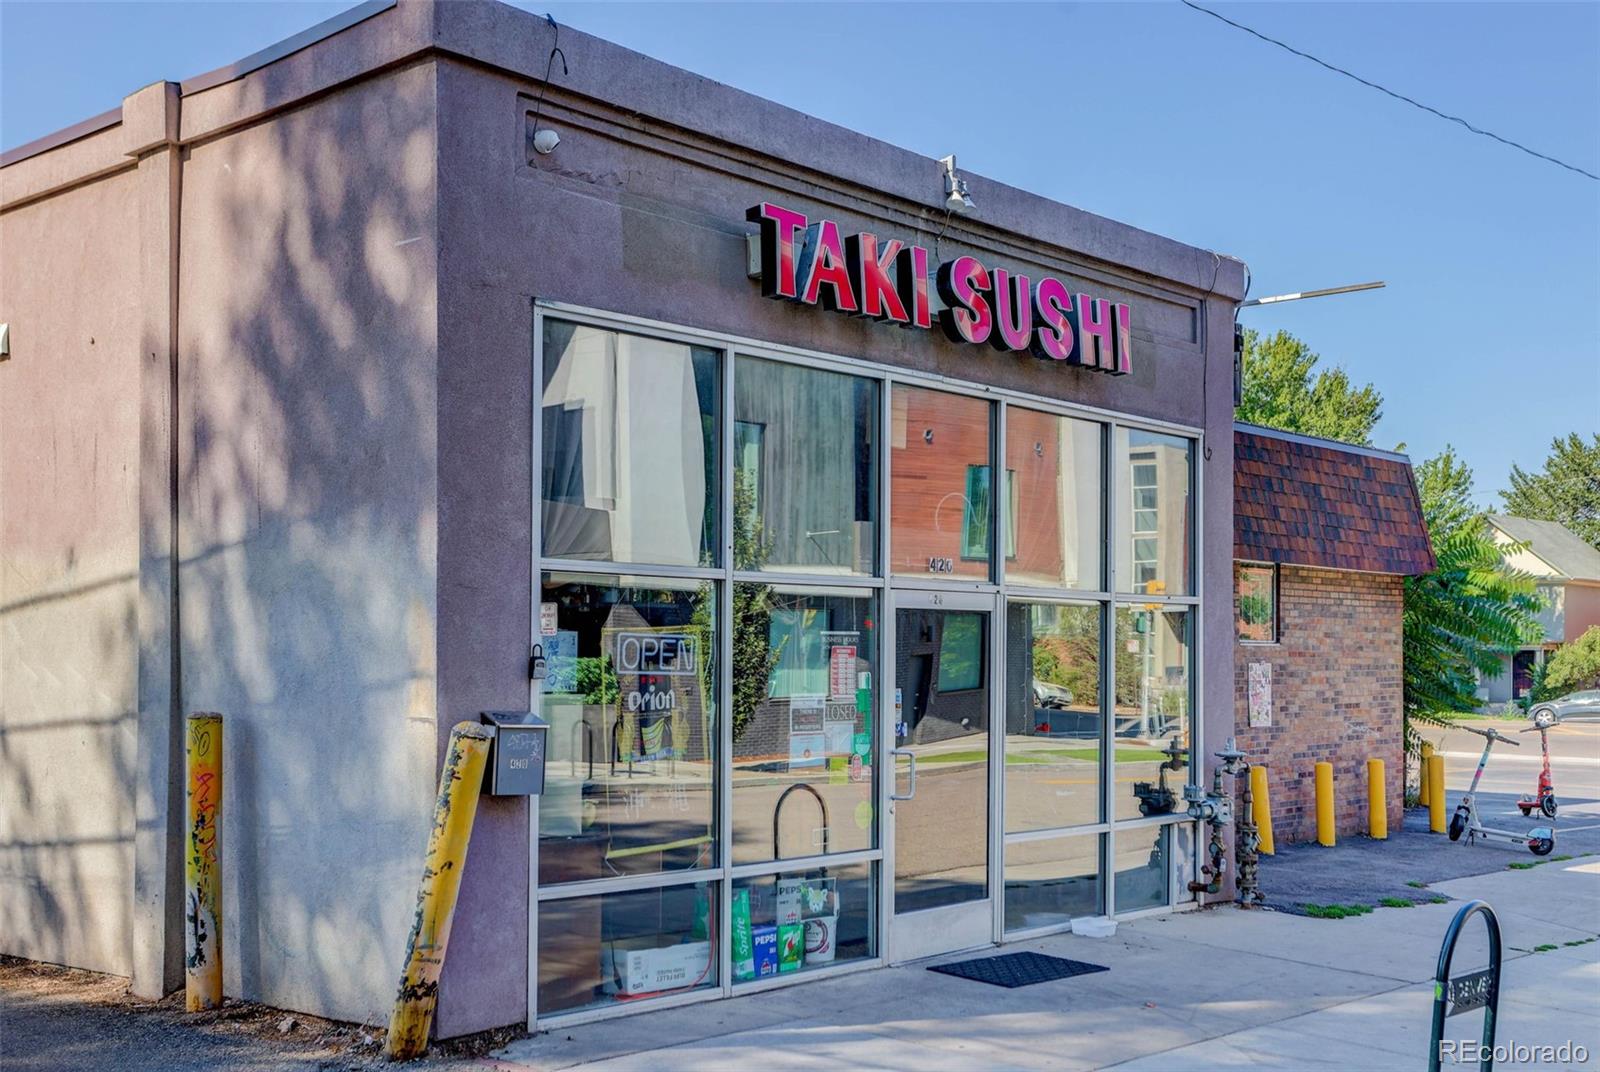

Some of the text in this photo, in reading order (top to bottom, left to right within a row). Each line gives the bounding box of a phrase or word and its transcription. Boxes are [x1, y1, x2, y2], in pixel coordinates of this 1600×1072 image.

[748, 202, 1132, 375] TAKI SUSHI
[930, 558, 953, 573] 420
[622, 638, 693, 671] OPEN
[827, 704, 857, 721] LOSED
[779, 886, 802, 896] PEPS
[736, 916, 749, 956] Sprite
